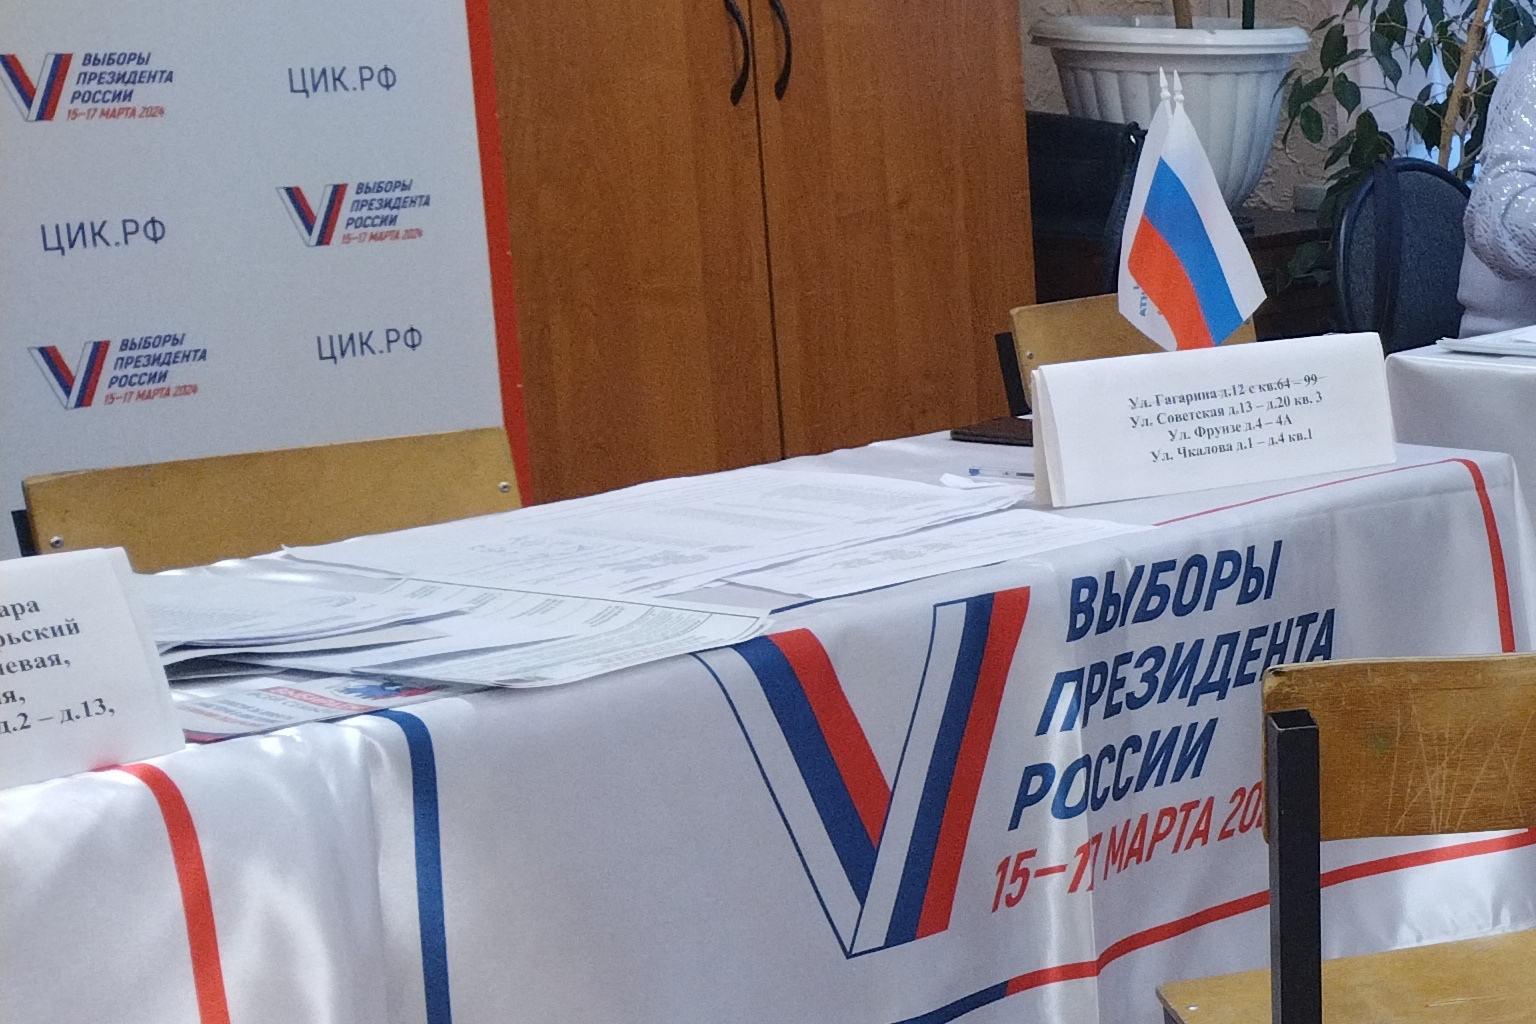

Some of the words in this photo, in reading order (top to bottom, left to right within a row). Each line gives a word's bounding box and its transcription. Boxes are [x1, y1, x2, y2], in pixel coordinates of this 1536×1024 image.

[81, 51, 151, 66] ВЫБОРЫ
[75, 69, 174, 86] ПРЕЗИДЕНТА
[288, 65, 397, 98] ЦИК.РФ
[70, 89, 133, 105] РОССИИ
[99, 106, 137, 120] МАРТА
[355, 179, 414, 195] ВЫБОРЫ
[350, 194, 431, 213] ПРЕЗИДЕНТА
[345, 214, 399, 230] РОССИИ
[40, 216, 166, 257] ЦИК.РФ
[369, 230, 400, 243] МАРТА
[118, 332, 187, 353] ВЫБОРЫ
[316, 326, 423, 365] ЦИК.РФ
[113, 348, 208, 371] ПРЕЗИДЕНТА
[107, 370, 169, 389] РОССИИ
[135, 385, 171, 403] МАРТА
[1128, 397, 1152, 410] Ул.
[1155, 390, 1218, 406] Гагарина
[1220, 383, 1245, 398] д.12
[1258, 377, 1291, 393] кв.64
[1129, 416, 1153, 429] Ул.
[1156, 407, 1225, 425] Советская
[1228, 401, 1253, 416] д.13
[1266, 396, 1291, 411] д.20
[1294, 395, 1313, 406] кв.
[1315, 390, 1323, 403] 3
[1167, 429, 1191, 442] Ул.
[1193, 422, 1242, 440] Фрунзе
[1245, 417, 1262, 432] д.4
[1149, 450, 1174, 463] Ул.
[1177, 443, 1233, 459] Чкалова
[1236, 437, 1253, 453] д.1
[1267, 433, 1285, 447] д.4
[1288, 428, 1313, 443] кв.1
[1065, 539, 1283, 643] ВЫБОРЫ
[1034, 608, 1335, 737] ПРЕЗИДЕНТА
[60, 698, 115, 724] д.13,
[1008, 717, 1219, 832] РОССИИ
[1103, 795, 1215, 881] МАРТА
